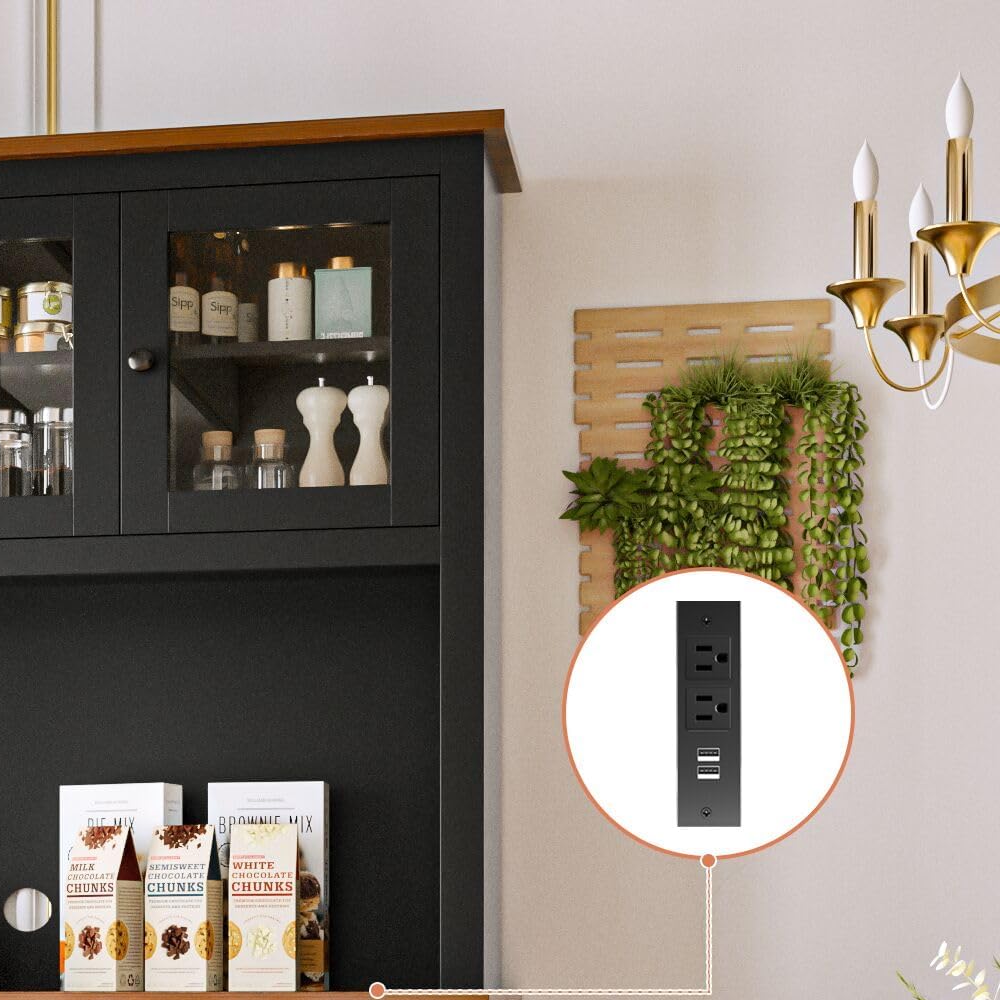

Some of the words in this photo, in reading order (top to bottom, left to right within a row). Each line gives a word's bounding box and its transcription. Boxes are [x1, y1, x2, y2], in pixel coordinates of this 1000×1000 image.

[171, 296, 194, 310] Sipp
[210, 301, 233, 315] Sipp
[69, 863, 96, 872] MILK
[149, 863, 206, 871] SEMISWEET
[232, 861, 275, 870] WHITE
[148, 872, 205, 880] CHOCOLATE
[231, 871, 293, 879] CHOCOLATE
[66, 882, 114, 893] CHUNKS
[147, 881, 204, 893] CHUNKS
[231, 881, 293, 892] CHUNKS
